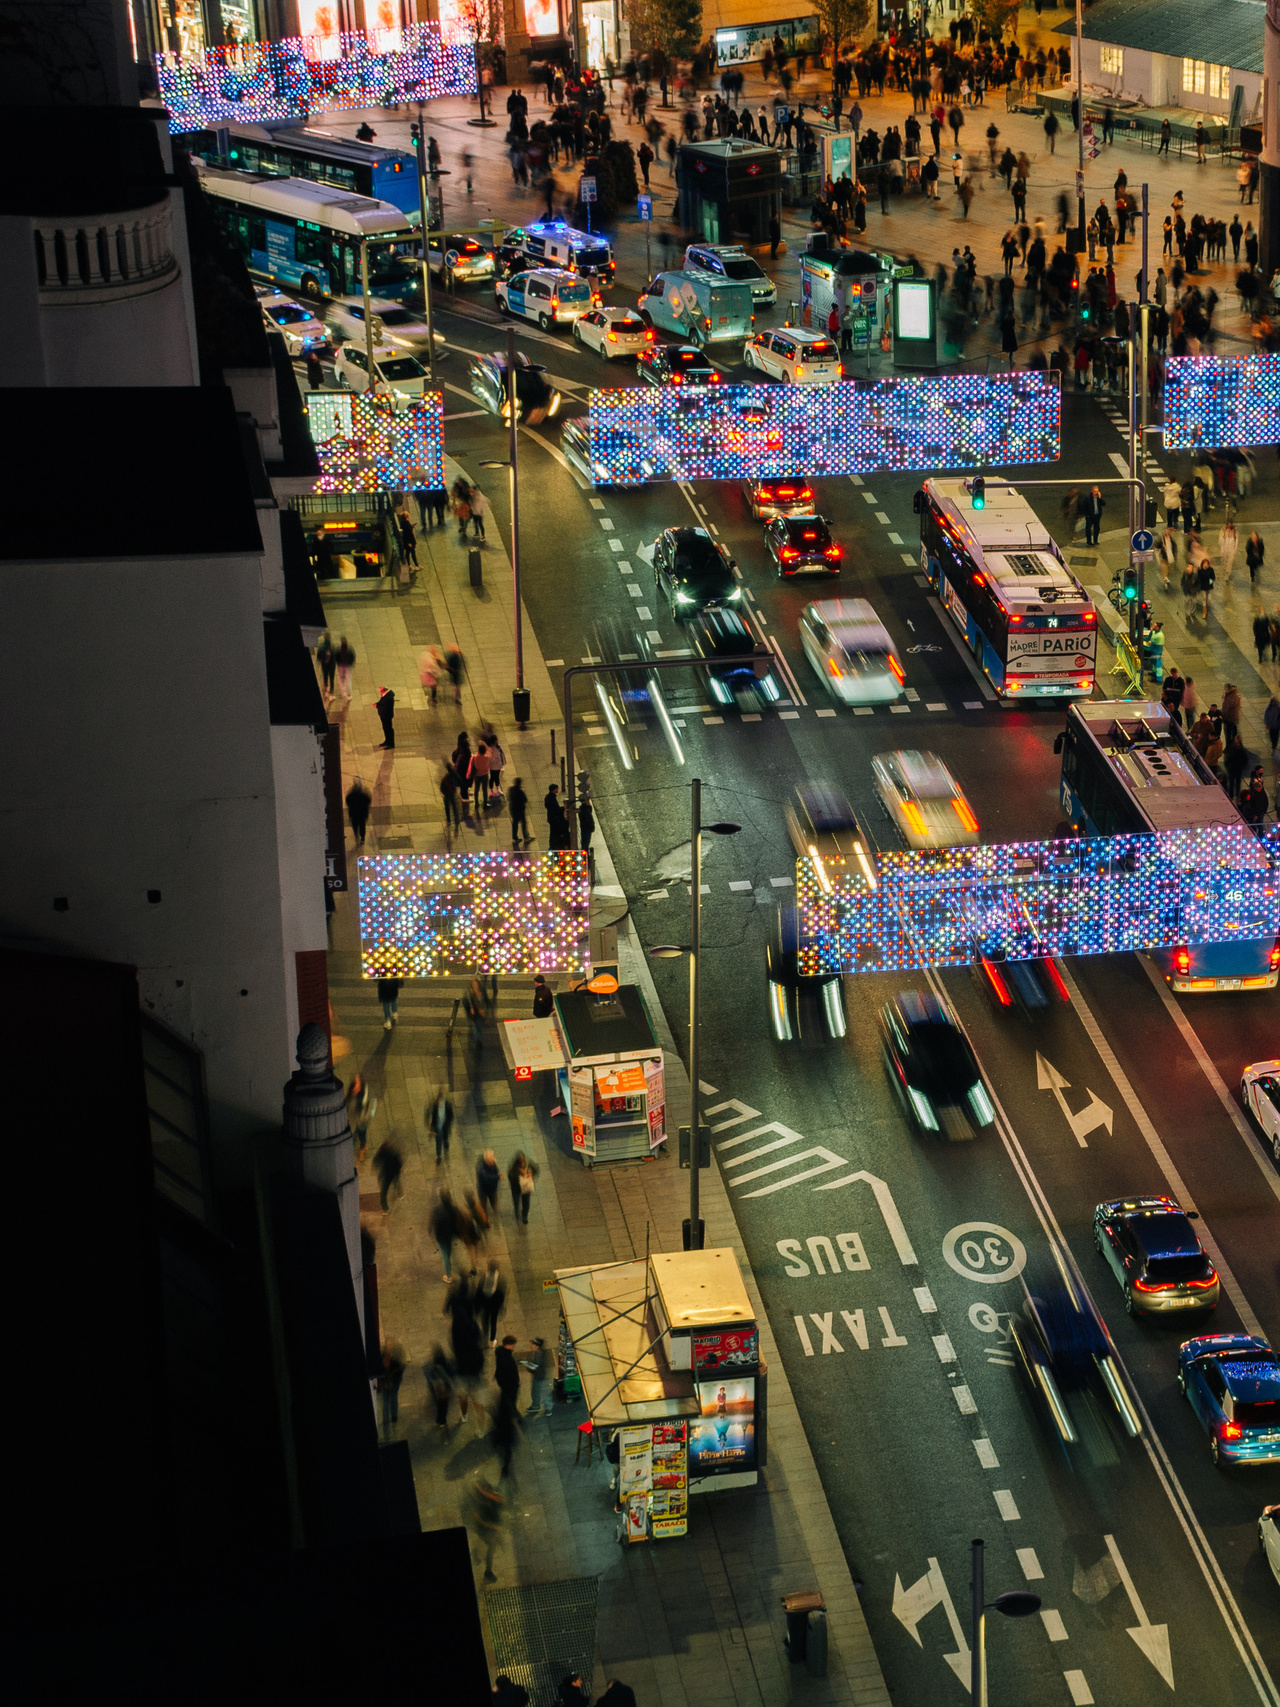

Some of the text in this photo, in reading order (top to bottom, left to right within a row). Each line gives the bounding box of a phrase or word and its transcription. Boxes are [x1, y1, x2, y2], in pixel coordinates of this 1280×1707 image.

[1047, 618, 1058, 628] 74
[1010, 640, 1038, 652] MADRE
[1225, 890, 1243, 901] 46
[776, 1232, 872, 1278] BUS
[961, 1237, 1009, 1269] 30
[793, 1306, 908, 1357] TAXI
[655, 1520, 686, 1528] TABACO
